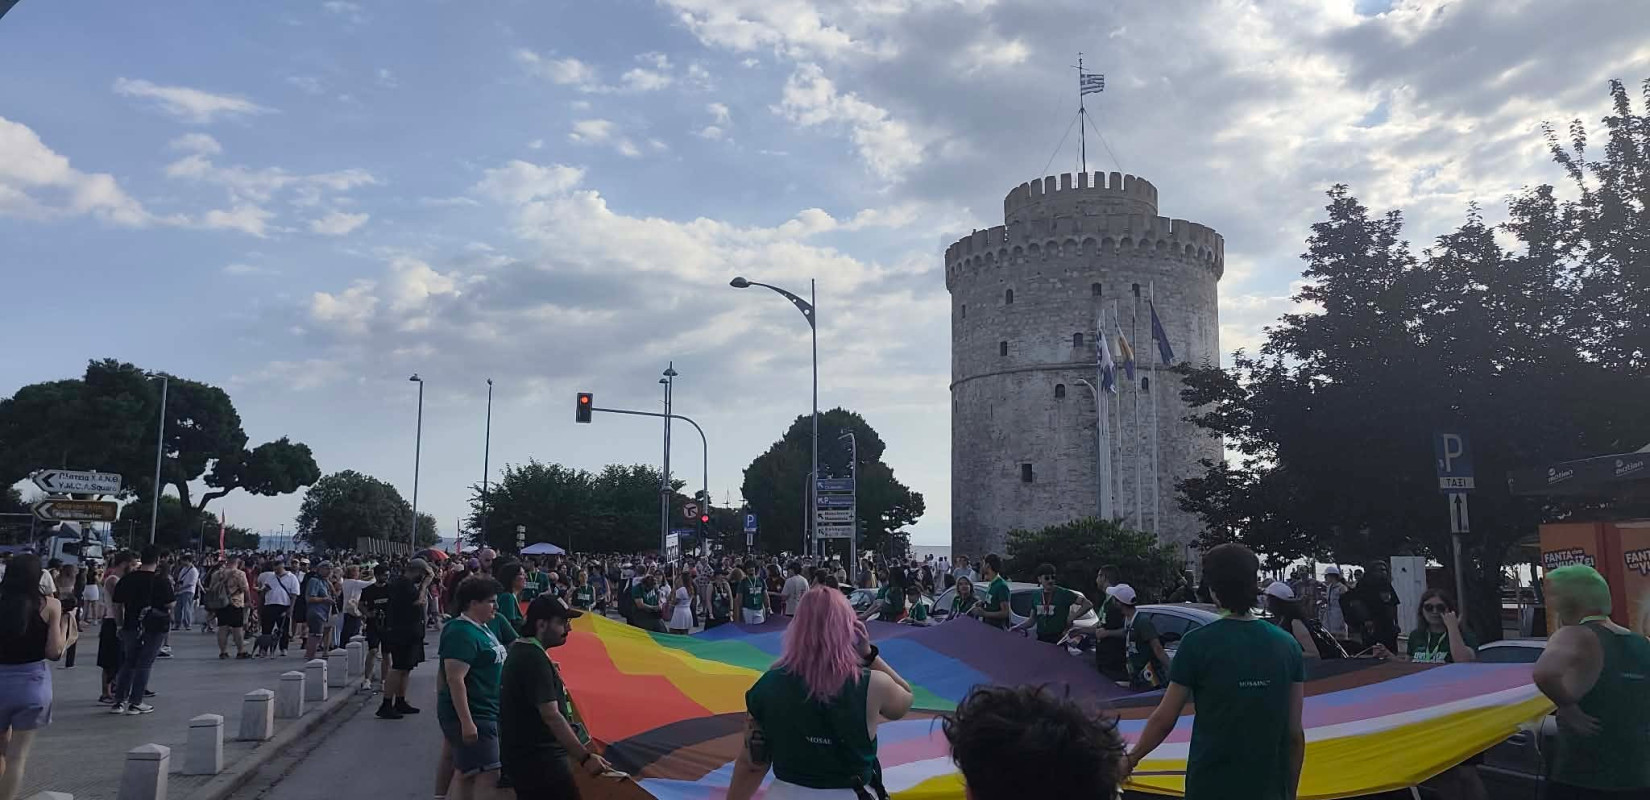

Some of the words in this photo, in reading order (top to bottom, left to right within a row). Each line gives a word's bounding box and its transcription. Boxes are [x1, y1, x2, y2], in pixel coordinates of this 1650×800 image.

[1442, 433, 1463, 473] P
[747, 514, 754, 527] P
[1544, 550, 1573, 563] FANTA
